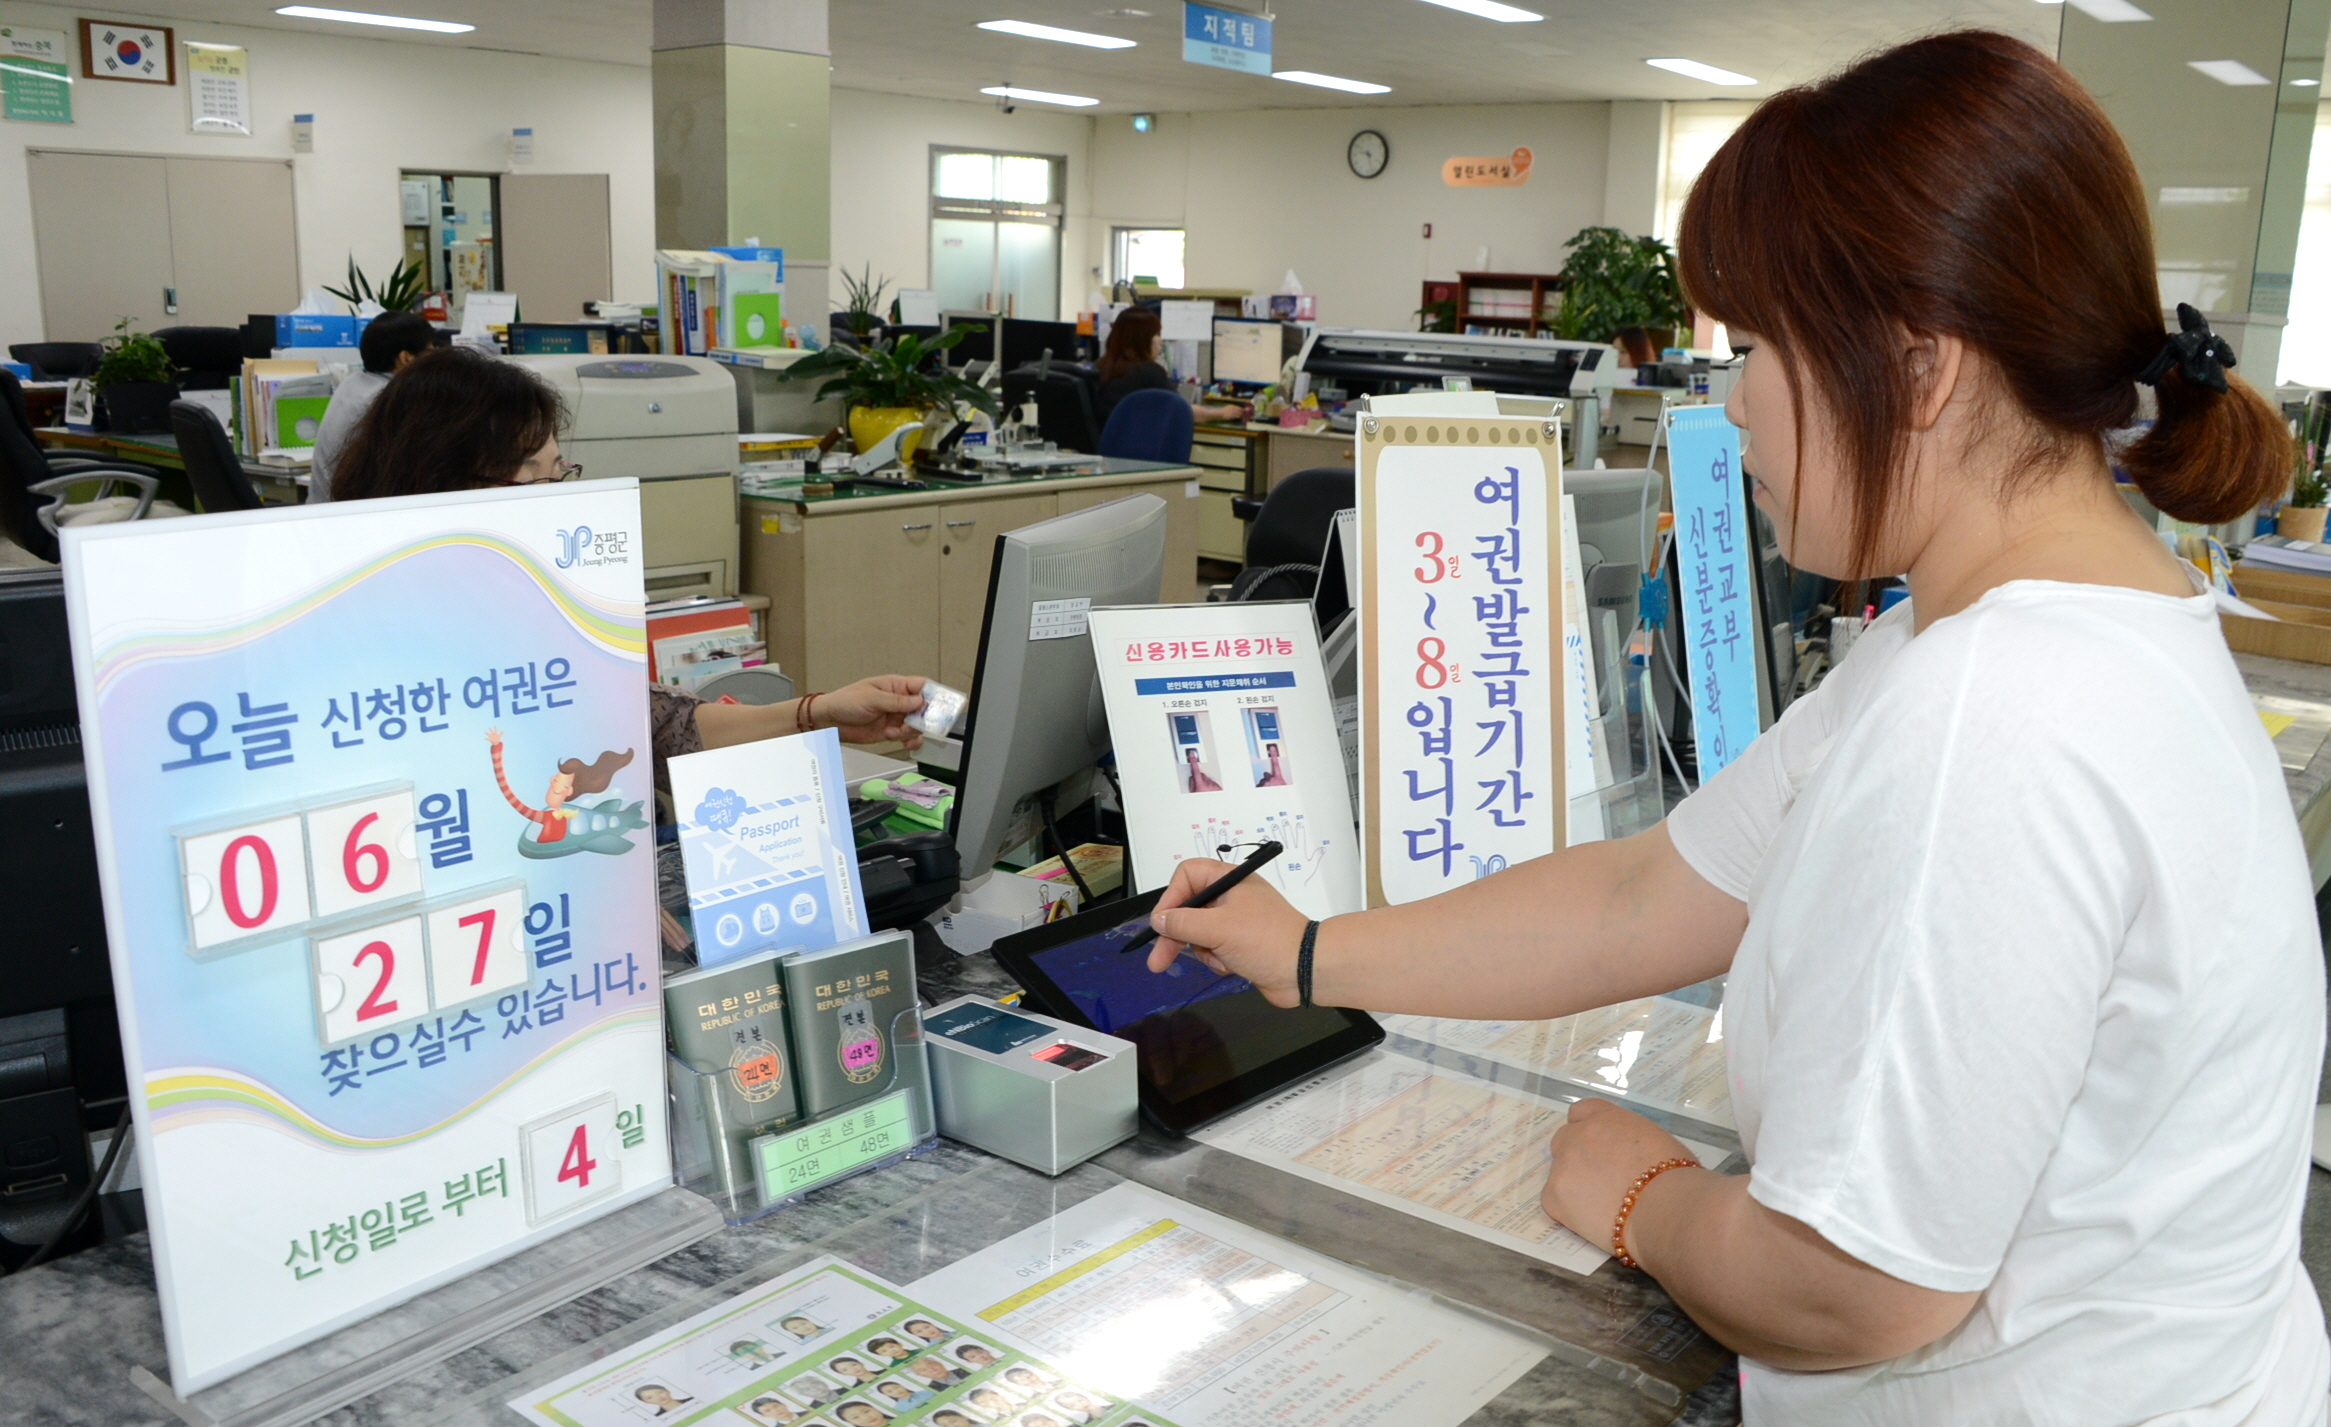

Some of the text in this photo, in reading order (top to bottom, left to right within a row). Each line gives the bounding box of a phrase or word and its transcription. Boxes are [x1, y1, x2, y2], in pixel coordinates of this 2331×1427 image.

[1203, 15, 1254, 47] 지적팀
[594, 531, 628, 555] 증평군
[1711, 447, 1741, 662] 여권교부
[582, 556, 628, 567] Jeung Pyeong
[1597, 594, 1633, 607] SAMSUNG
[1470, 465, 1535, 828] 여권발급기간
[1166, 679, 1204, 691] 본인확인을
[1205, 678, 1220, 688] 위한
[1252, 677, 1267, 686] 순서
[161, 657, 577, 773] 오늘 신청한 여권은
[740, 815, 800, 841] Passport
[759, 836, 803, 853] Application
[772, 855, 789, 864] Thank
[815, 969, 889, 998] 대한민국
[698, 984, 784, 1017] 대한민국
[817, 985, 891, 1012] REPUBLIC OF KOREA
[320, 953, 647, 1097] 찾으실수 있습니다.
[701, 1000, 786, 1032] REPUBLIC OF KOREA
[842, 1010, 866, 1026] 견본
[735, 1025, 762, 1043] 견본
[849, 1044, 878, 1061] 48면
[796, 1111, 877, 1152] 여권샘플
[788, 1131, 890, 1184] 24면 48면
[284, 1190, 434, 1281] 신청일로
[442, 1158, 509, 1217] 부터
[1016, 1239, 1092, 1278] 여권수수료
